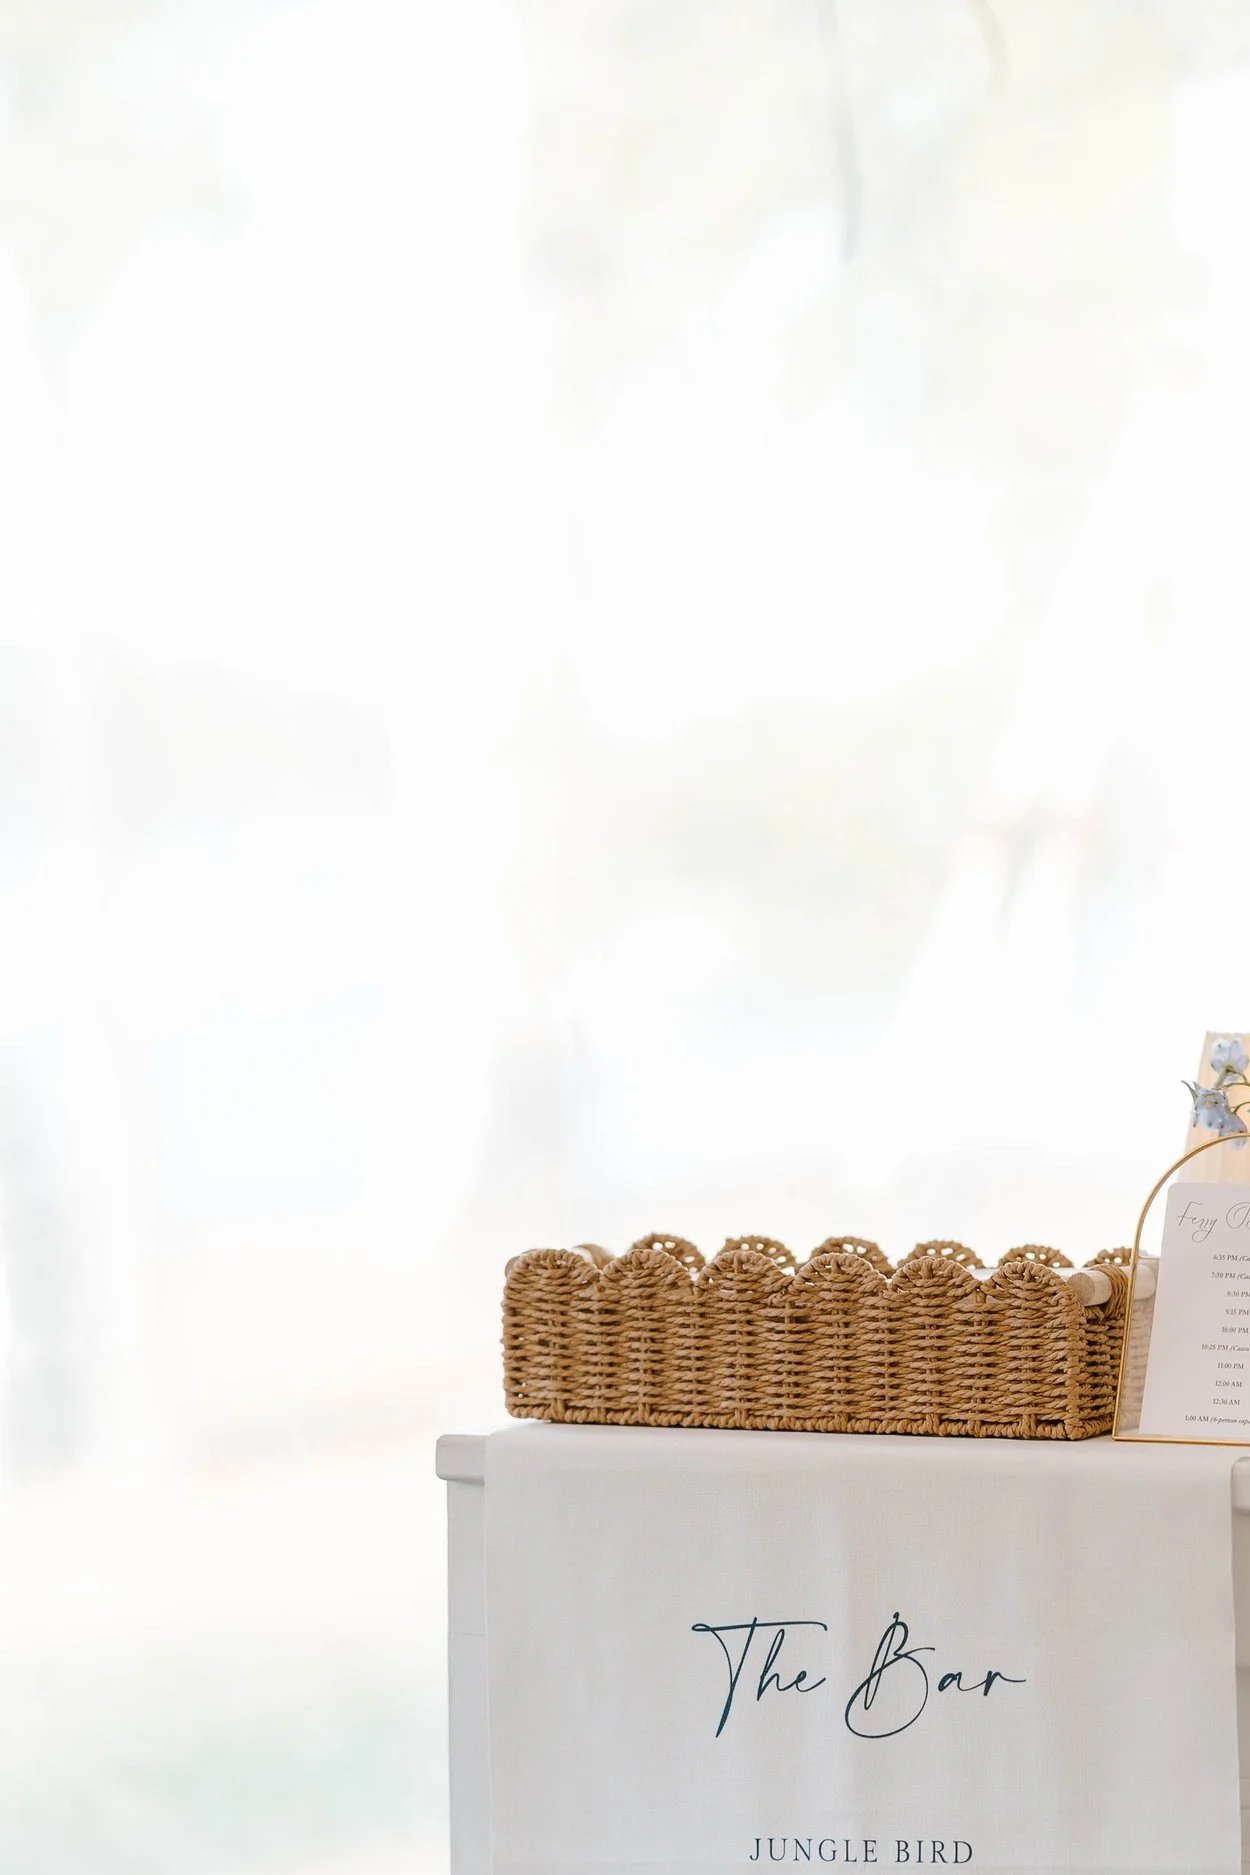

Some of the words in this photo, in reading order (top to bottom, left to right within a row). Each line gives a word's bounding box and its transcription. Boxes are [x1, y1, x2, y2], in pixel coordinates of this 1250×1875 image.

[1176, 1201, 1218, 1243] Ferry
[1198, 1415, 1209, 1423] AM
[690, 1616, 828, 1739] The
[844, 1611, 1027, 1740] Bar
[749, 1837, 878, 1863] JUNGLE
[895, 1839, 973, 1864] BIRD
